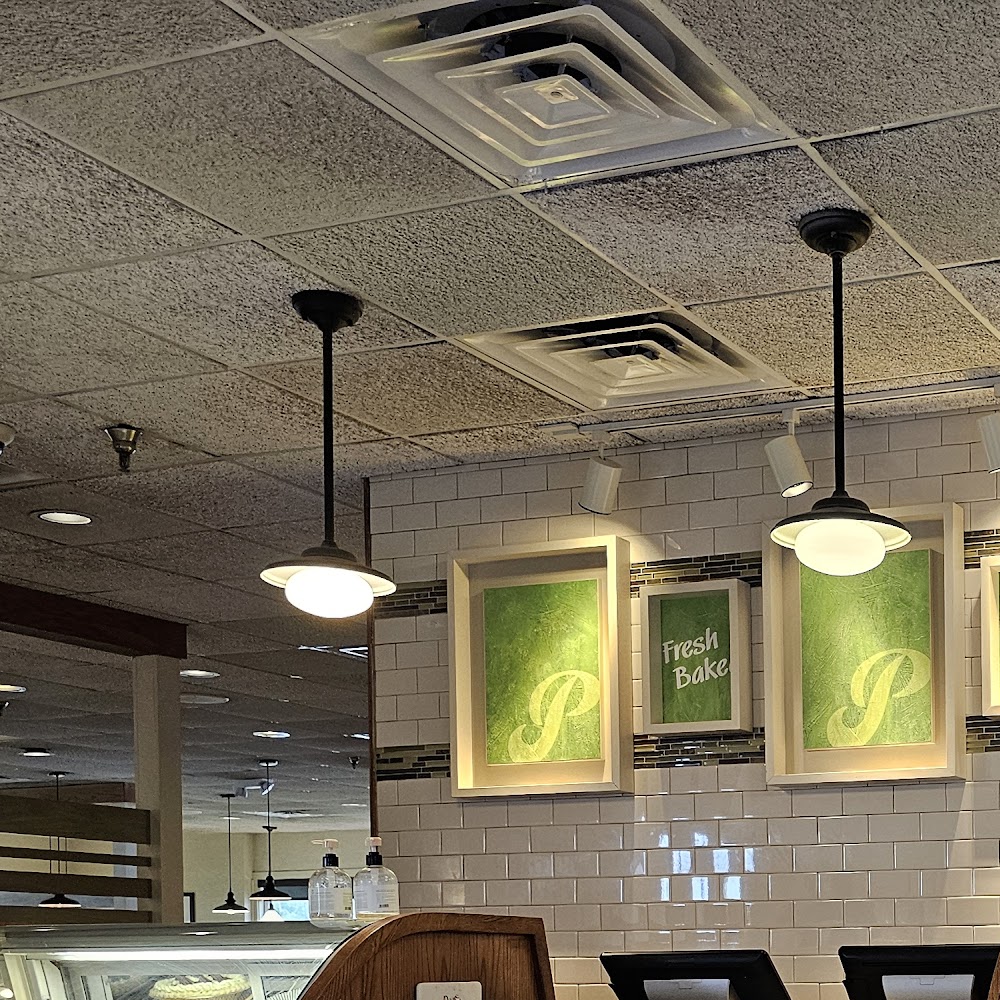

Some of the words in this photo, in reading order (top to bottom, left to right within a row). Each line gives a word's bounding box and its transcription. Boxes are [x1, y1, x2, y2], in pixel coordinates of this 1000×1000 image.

[662, 627, 719, 664] Fresh
[672, 656, 731, 690] Bake
[507, 669, 600, 763] P
[826, 648, 931, 748] P
